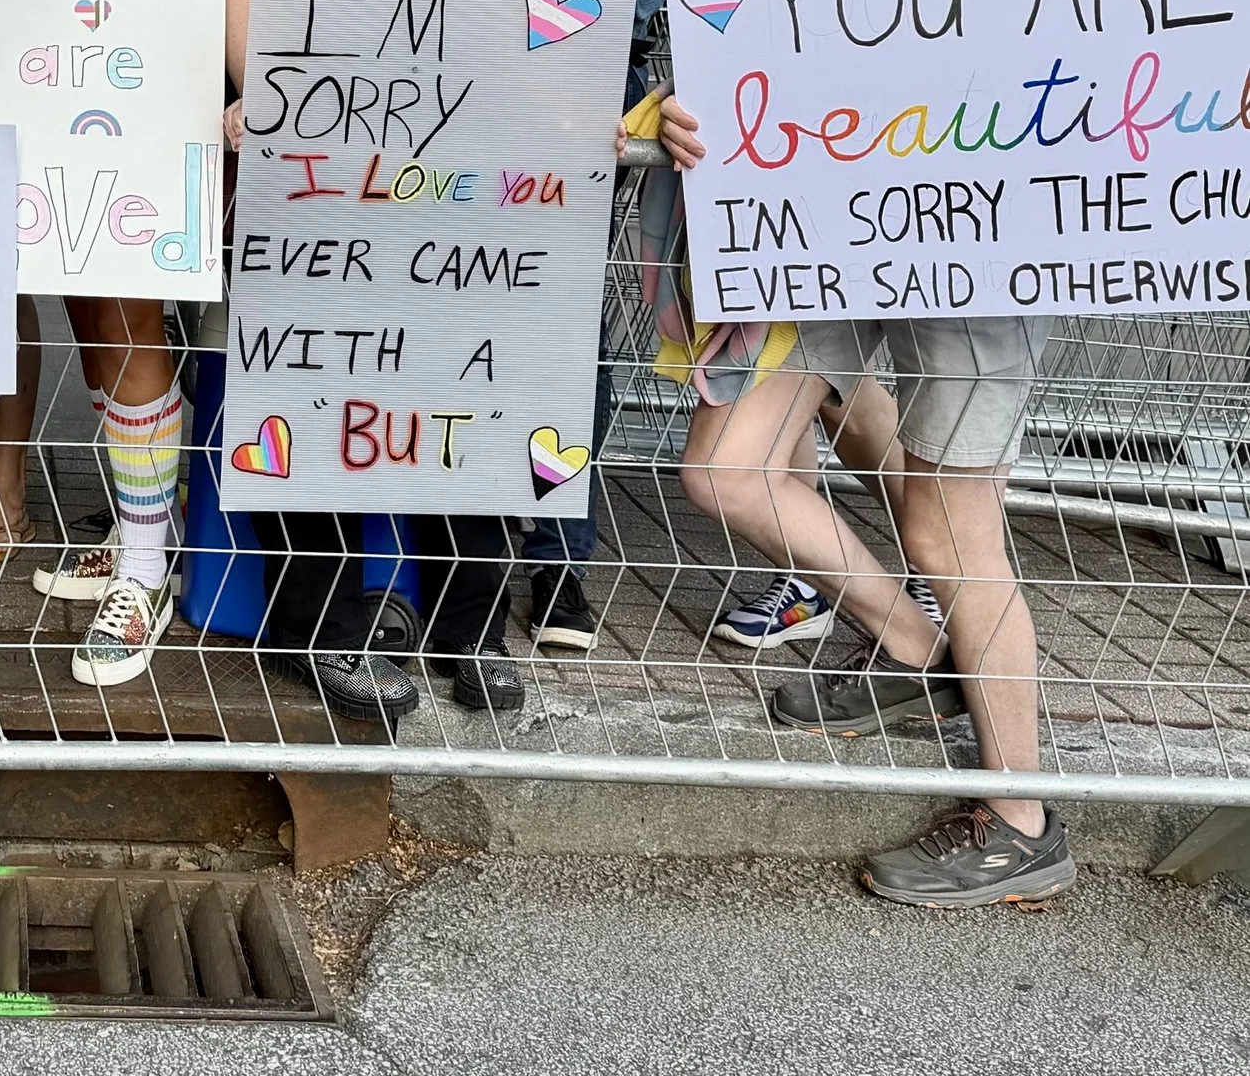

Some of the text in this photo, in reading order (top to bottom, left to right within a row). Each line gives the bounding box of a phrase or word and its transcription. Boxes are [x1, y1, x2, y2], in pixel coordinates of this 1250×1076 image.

[19, 44, 144, 89] are
[244, 66, 475, 159] SORRY
[358, 153, 480, 204] LOVE
[715, 196, 810, 254] I'M
[849, 178, 1007, 247] SORRY
[1030, 170, 1153, 235] THE
[240, 234, 548, 293] EVER CAME
[715, 262, 848, 314] EVER
[873, 260, 974, 310] SAID
[237, 316, 495, 382] WITH A
